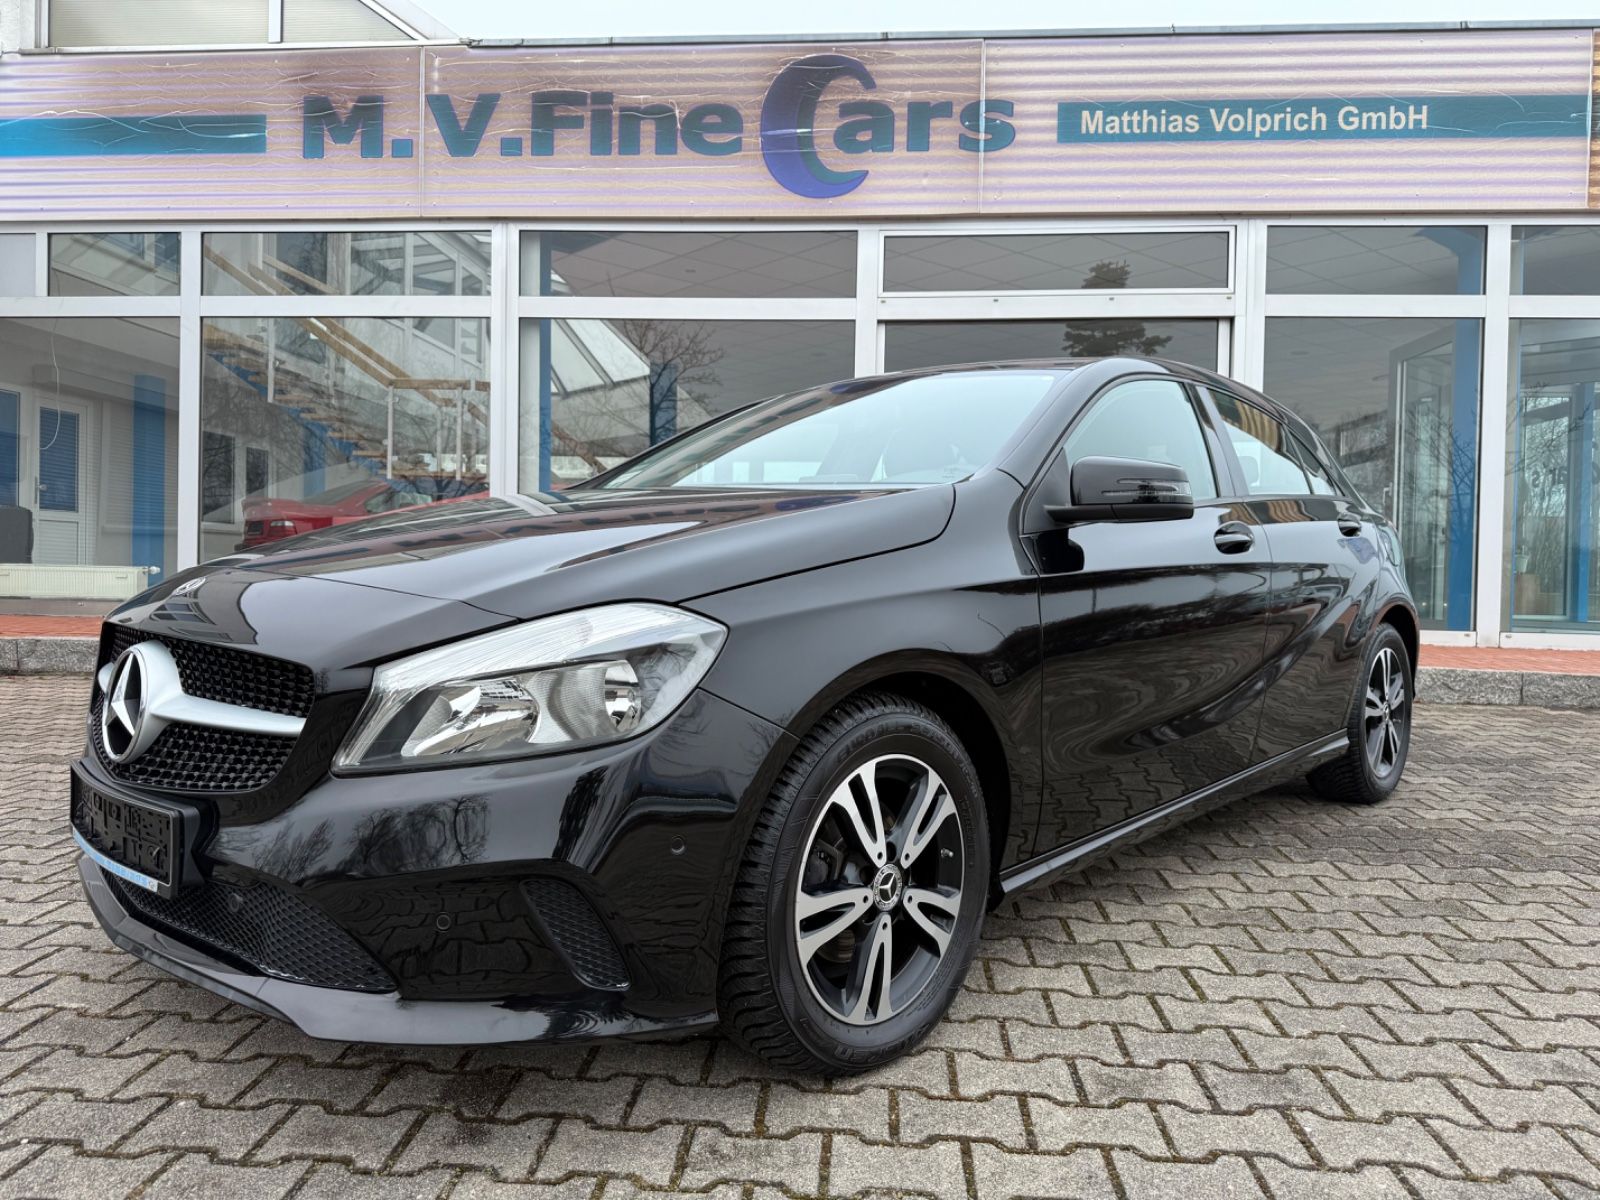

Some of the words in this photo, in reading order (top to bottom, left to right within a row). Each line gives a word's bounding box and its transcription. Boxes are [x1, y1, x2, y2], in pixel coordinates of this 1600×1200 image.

[1080, 109, 1200, 135] Matthias
[1209, 106, 1327, 138] Volprich
[1337, 104, 1429, 131] GmbH
